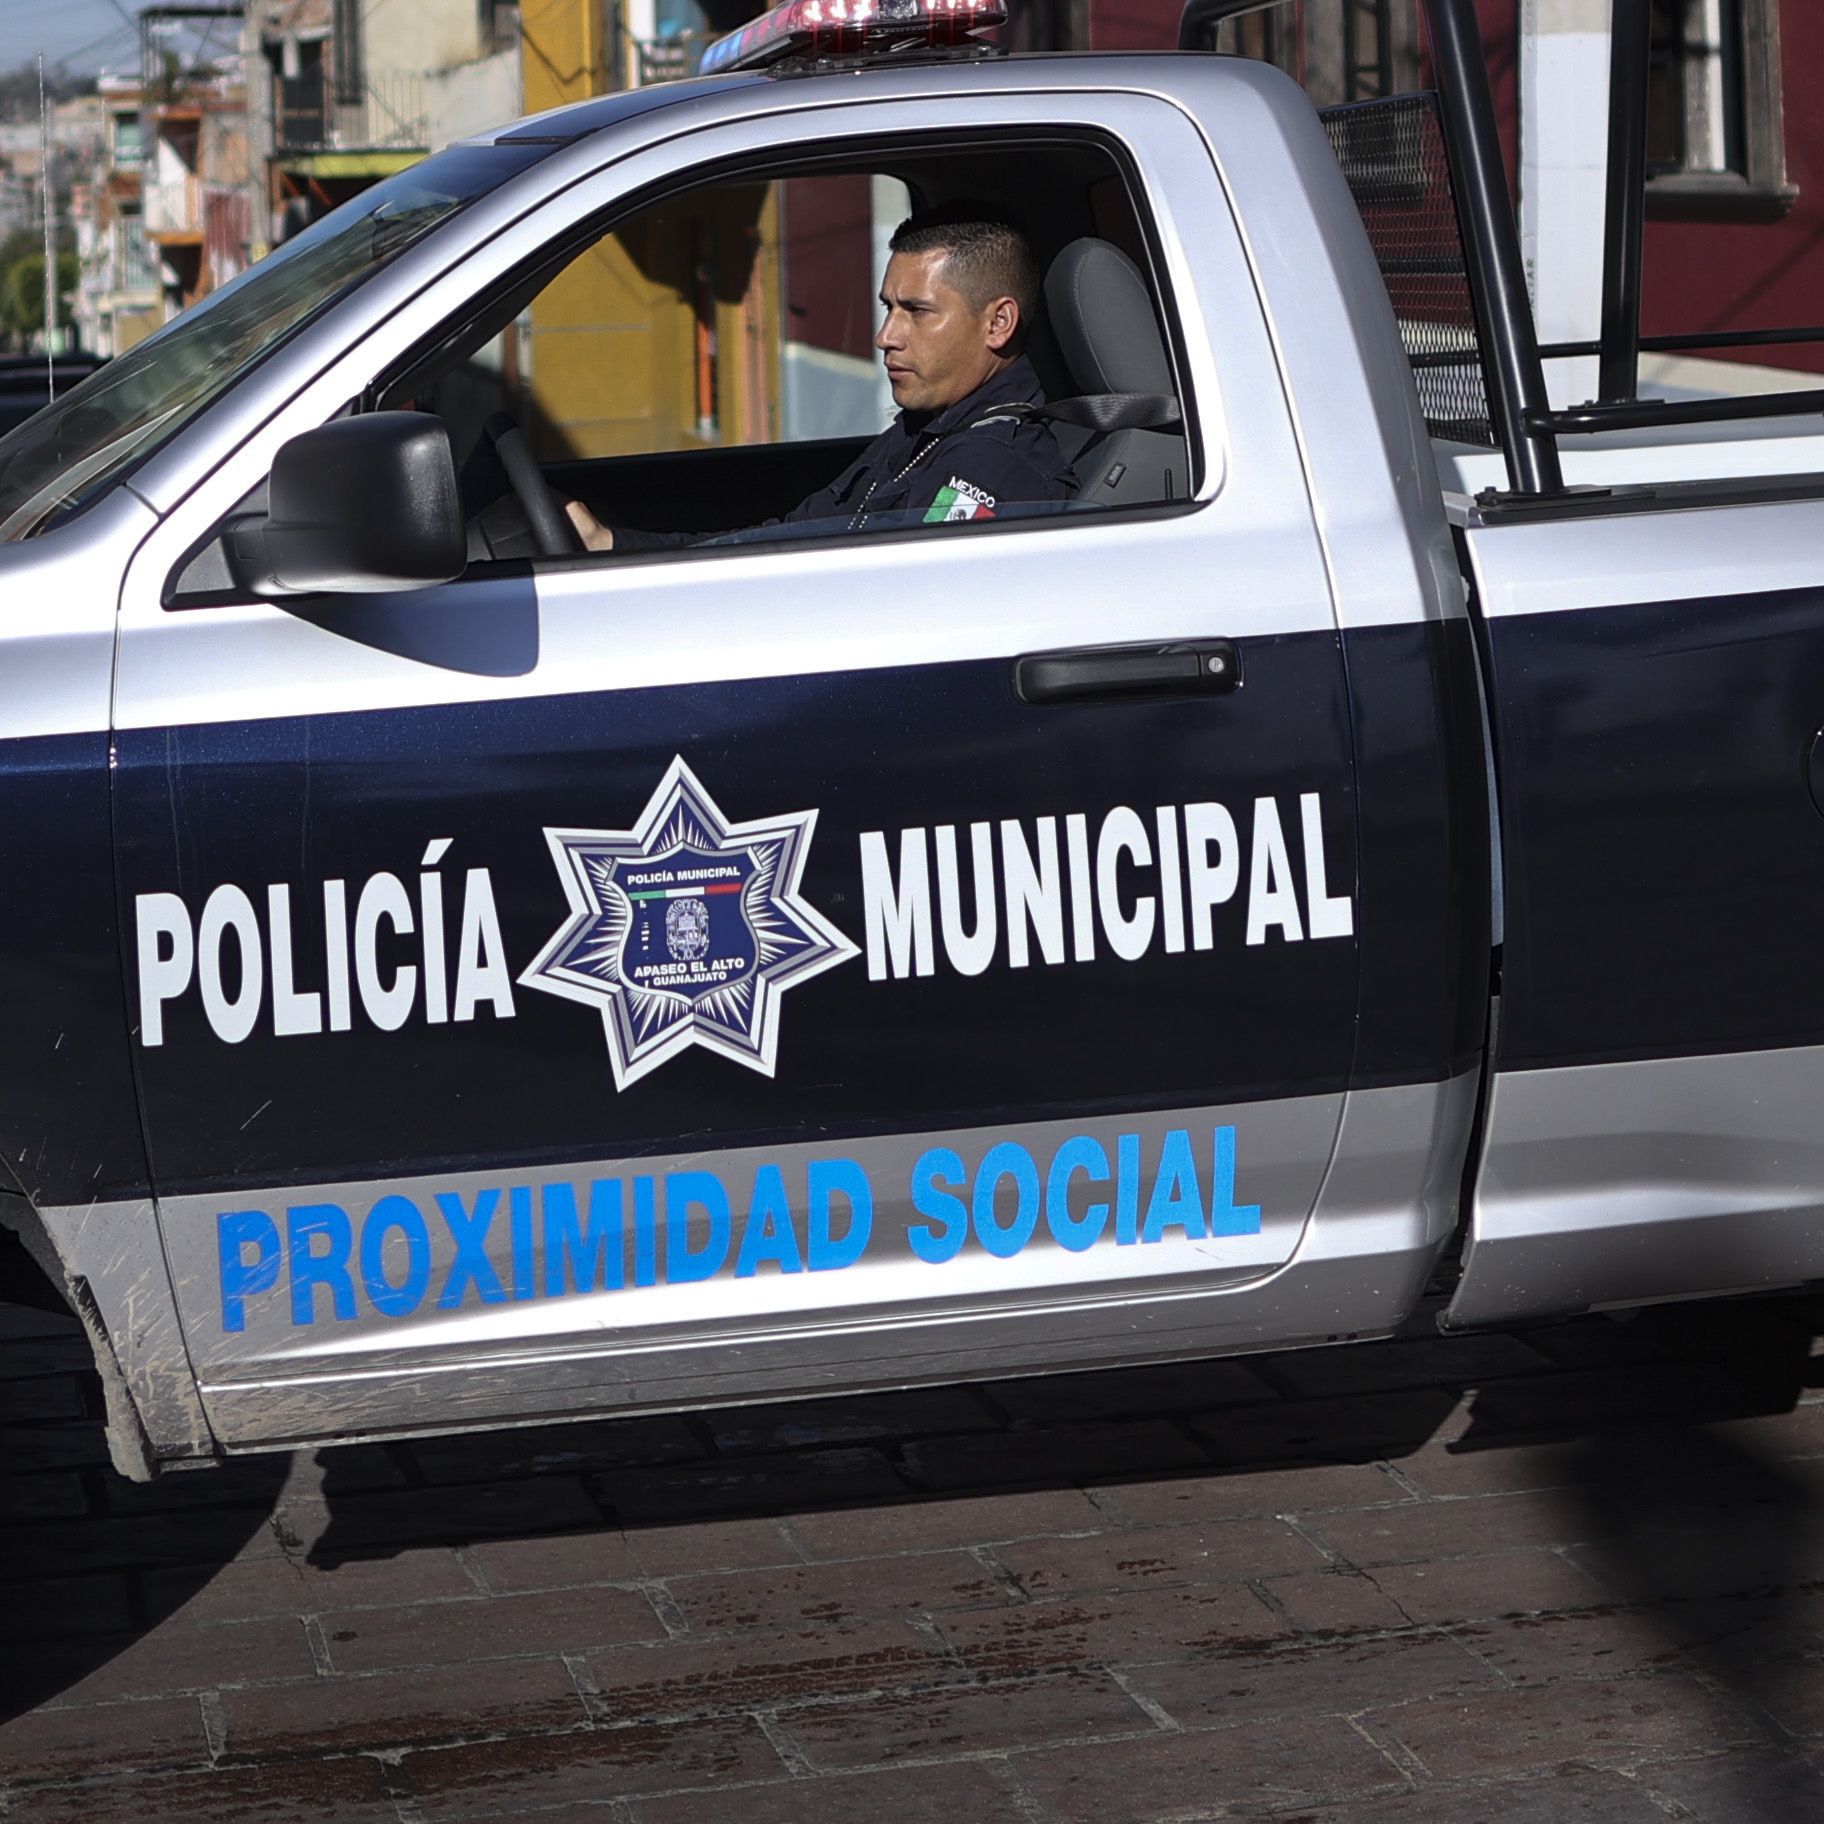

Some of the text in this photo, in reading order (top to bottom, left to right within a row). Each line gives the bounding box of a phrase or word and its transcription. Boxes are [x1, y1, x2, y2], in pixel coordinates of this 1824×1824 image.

[949, 475, 996, 509] MEXICO
[627, 866, 741, 885] POLICÍA MUNICIPAL
[134, 792, 1355, 1048] POLICÍA MUNICIPAL
[634, 957, 745, 978] APASEO EL ALTO
[653, 971, 727, 986] GUANAJUATO
[216, 1124, 1263, 1335] PROXIMIDAD SOCIAL
